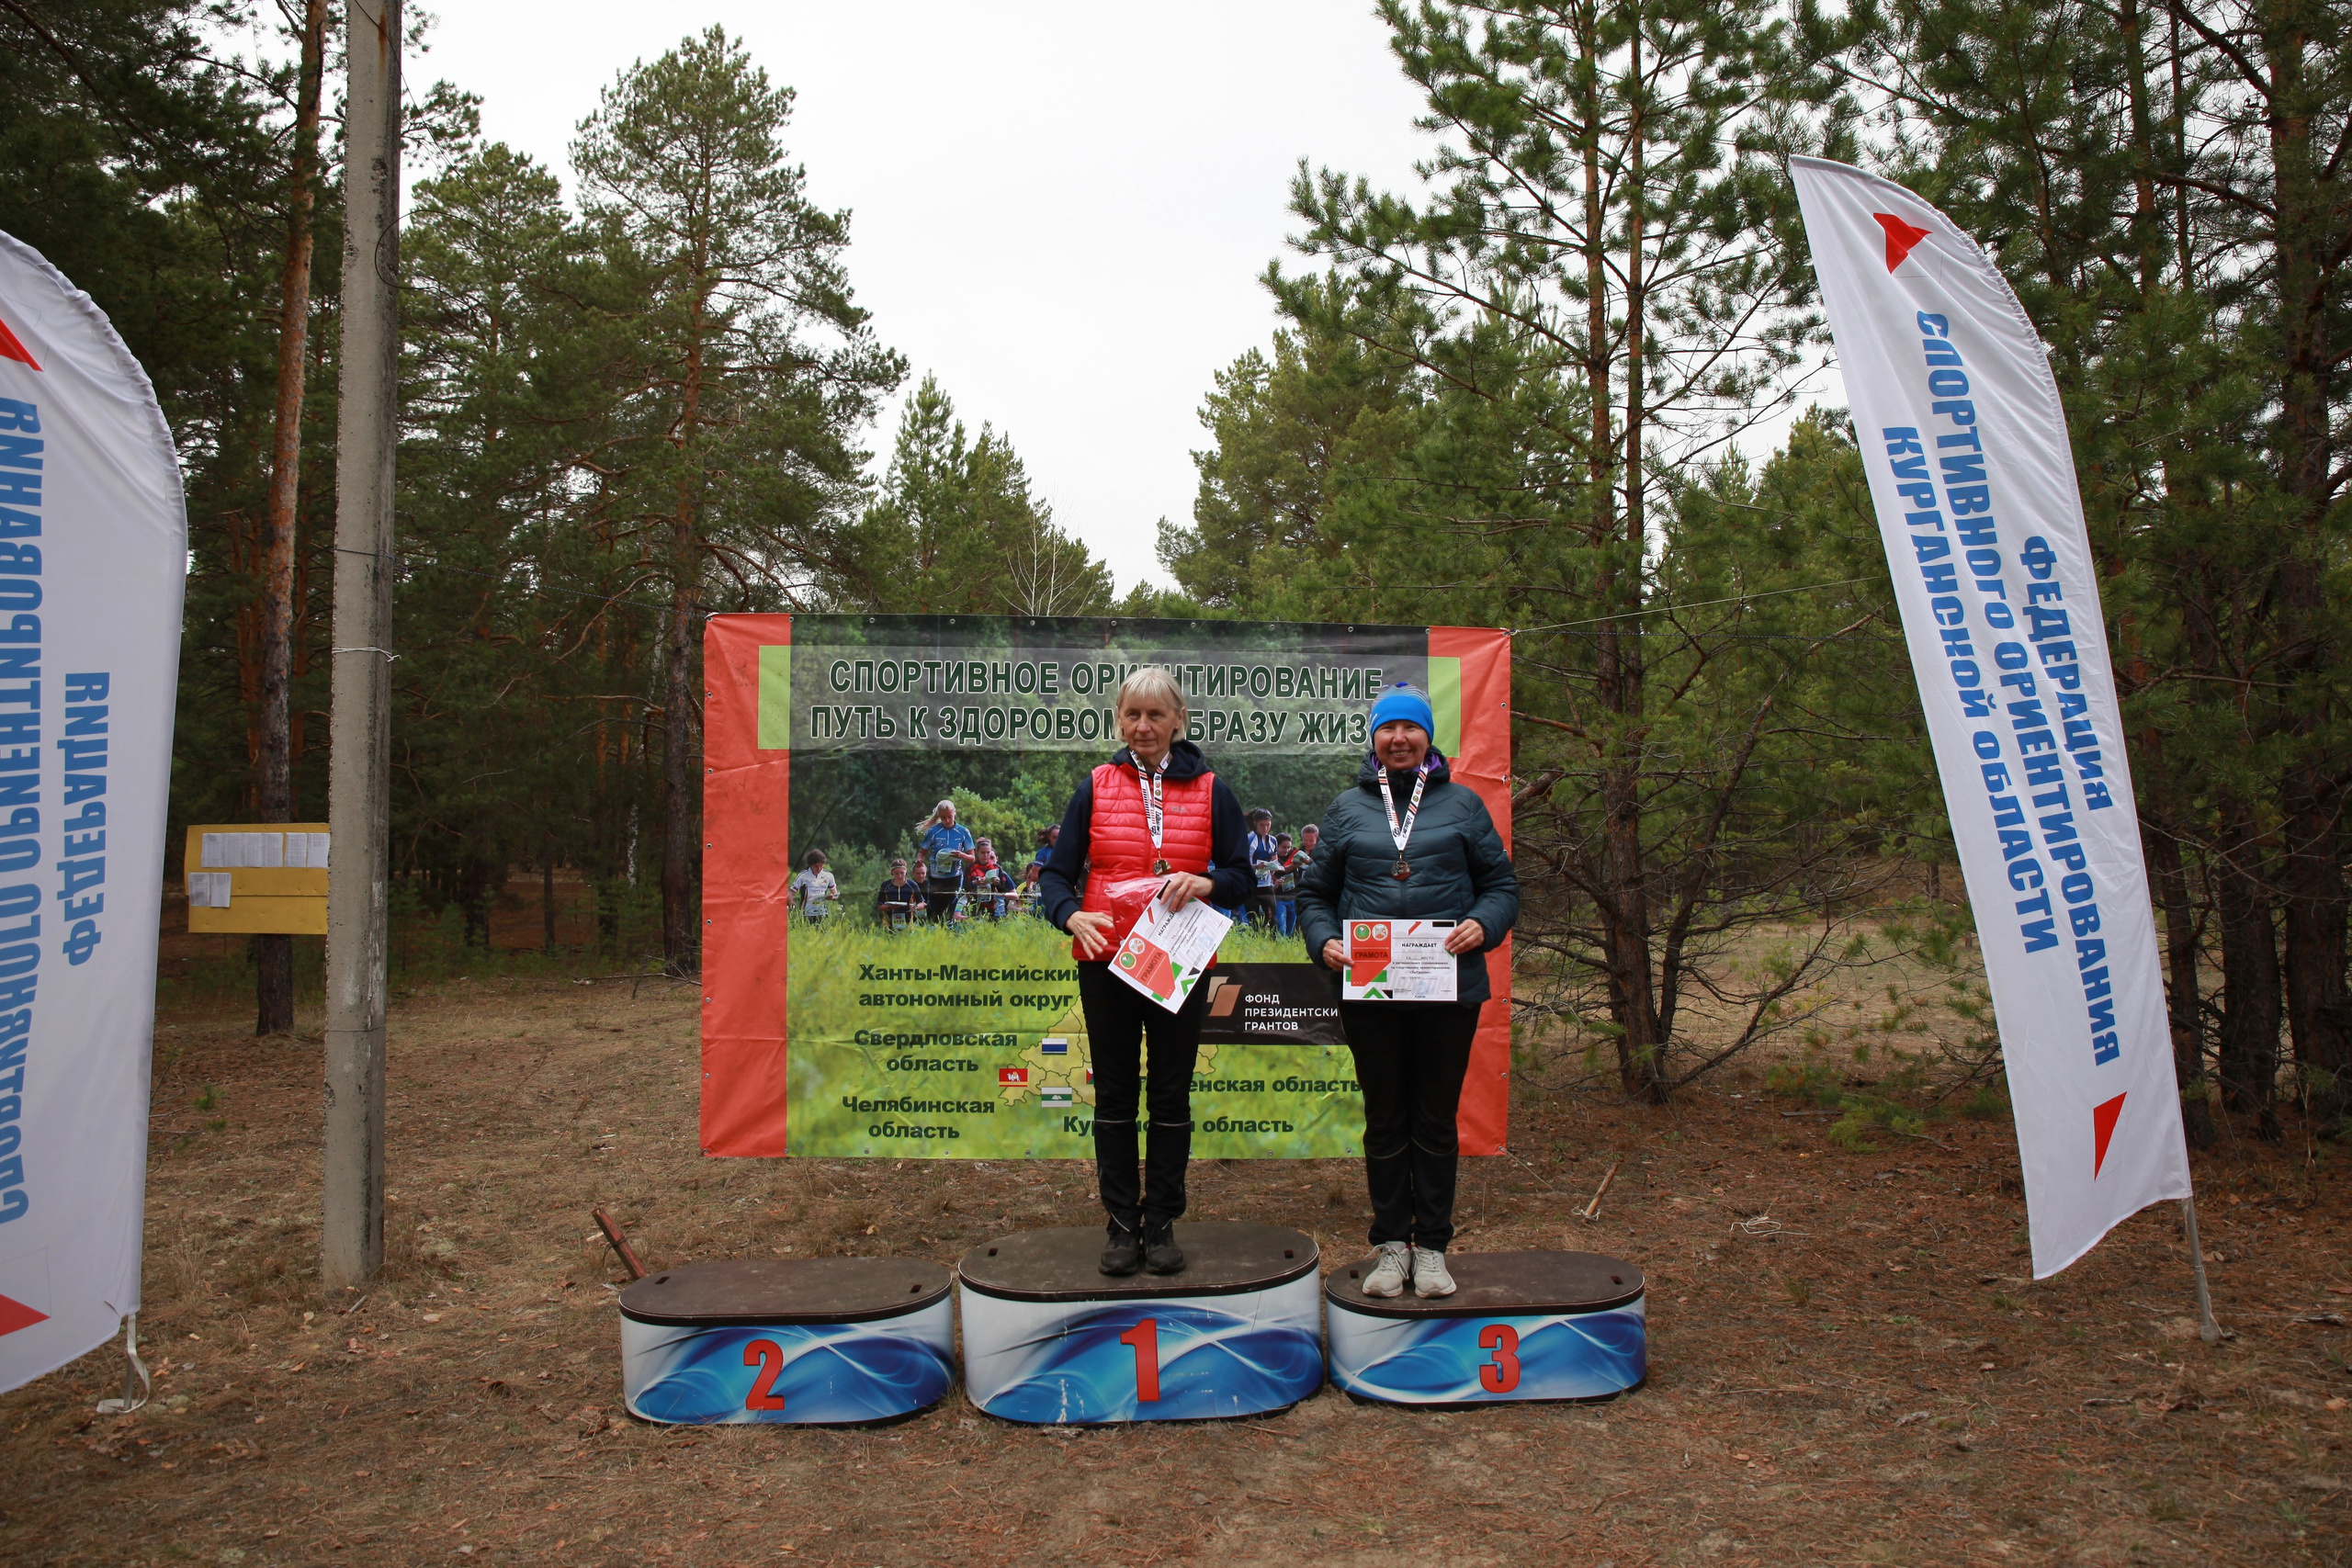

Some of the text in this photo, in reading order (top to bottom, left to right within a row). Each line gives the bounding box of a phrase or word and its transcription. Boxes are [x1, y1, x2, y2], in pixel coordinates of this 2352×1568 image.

[830, 660, 1383, 700] СПОРТИВНОЕ ОРИНТИРОВАНИЕ
[2019, 536, 2113, 812] ФЕДЕРАЦИЯ
[1882, 427, 2059, 953] КУРГАНСКОЙ ОБЛАСТИ
[1917, 310, 2120, 1067] СПОРТИВНОГО ОРИЕНТИРОВАНИЯ
[810, 705, 1369, 746] ПУТЬ К ЗДОРОВОМ БРАЗУ ЖИЗ
[1140, 952, 1163, 982] ГРАМОТА
[859, 990, 1073, 1010] автономный округ
[1245, 994, 1280, 1005] ФОНД
[1245, 1008, 1339, 1018] ПРЕЗИДЕНТСКИ
[1244, 1021, 1298, 1031] ГРАНТОВ
[854, 1030, 1017, 1049] Свердловская
[887, 1055, 979, 1072] область
[1272, 1076, 1362, 1092] область
[842, 1096, 995, 1114] Челябинская
[868, 1122, 960, 1139] область
[1203, 1117, 1294, 1134] область
[1119, 1317, 1161, 1404] 1
[1477, 1324, 1521, 1394] 3
[742, 1338, 786, 1412] 2
